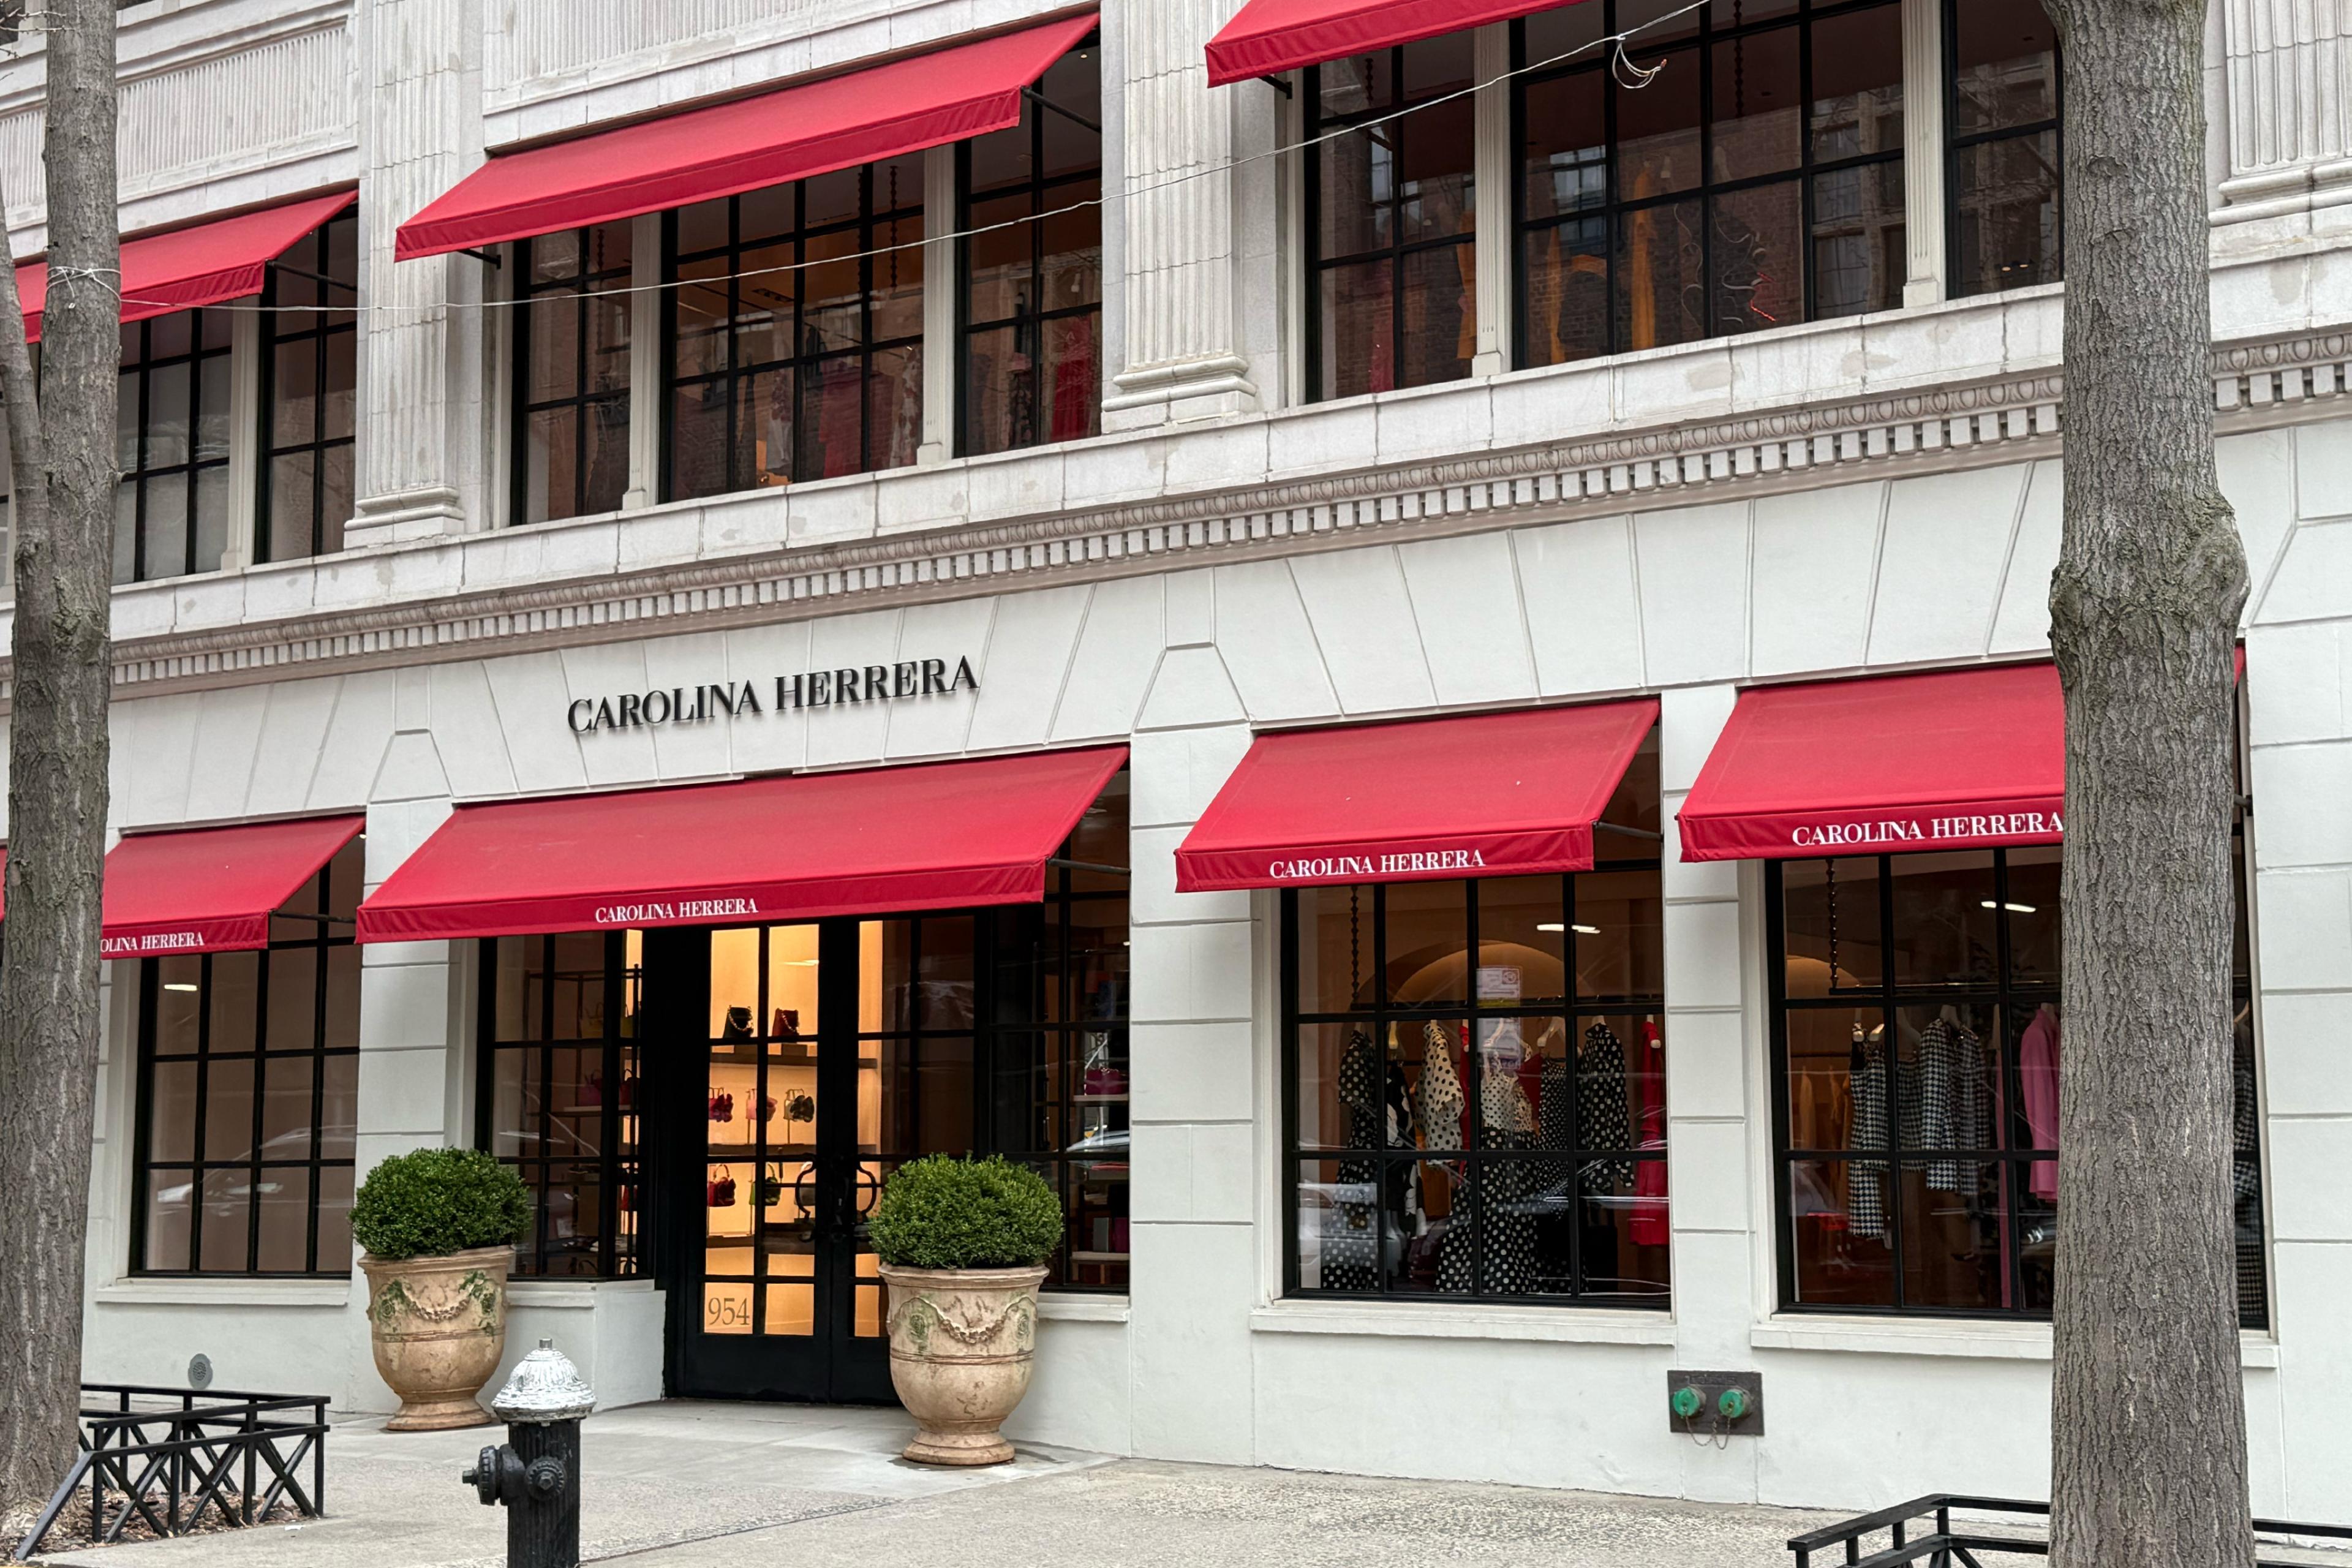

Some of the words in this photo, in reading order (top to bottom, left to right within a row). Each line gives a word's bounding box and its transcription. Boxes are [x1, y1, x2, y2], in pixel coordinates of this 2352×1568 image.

[568, 679, 762, 733] CAROLINA
[774, 655, 980, 710] HERRERA
[1792, 821, 1924, 846] CAROLINA
[1931, 812, 2064, 839] HERRERA
[1269, 856, 1375, 878] CAROLINA
[1380, 849, 1486, 873] HERRERA
[595, 903, 675, 923] CAROLINA
[679, 898, 759, 918] HERRERA
[100, 937, 138, 952] OLINA
[141, 932, 205, 949] HERRERA
[708, 1297, 750, 1325] 954
